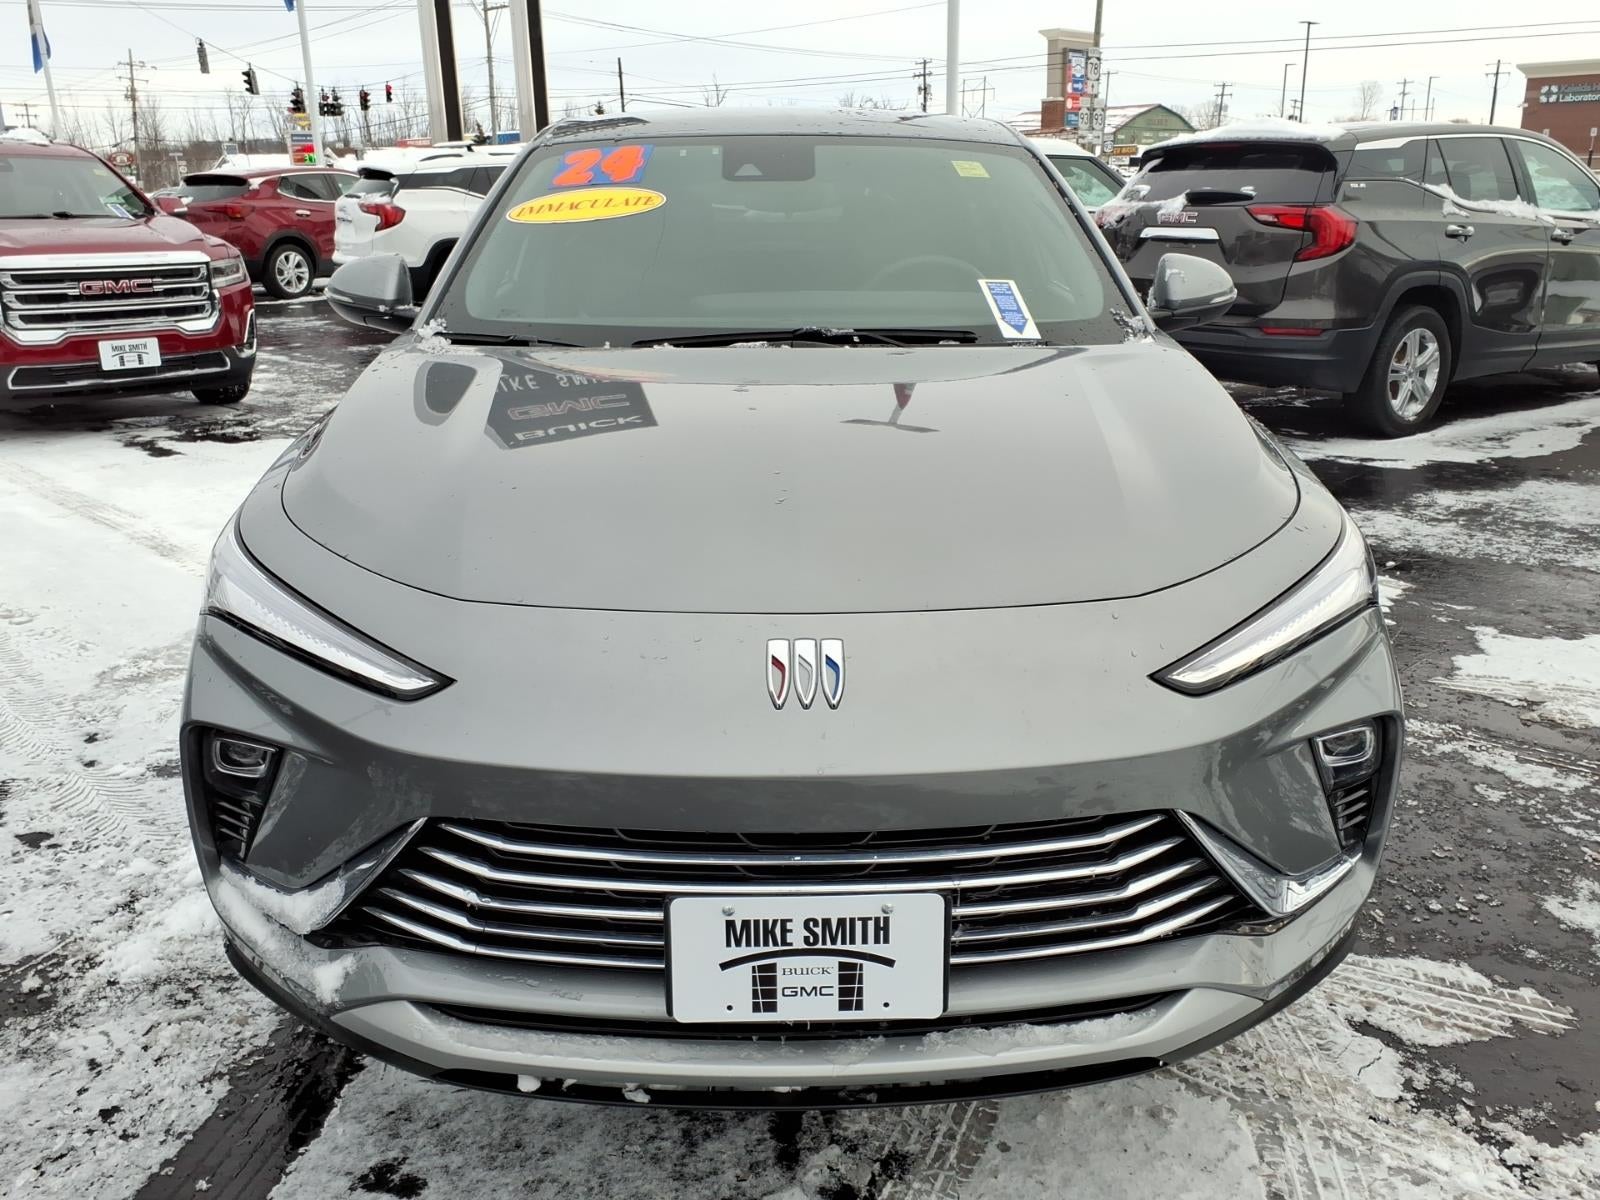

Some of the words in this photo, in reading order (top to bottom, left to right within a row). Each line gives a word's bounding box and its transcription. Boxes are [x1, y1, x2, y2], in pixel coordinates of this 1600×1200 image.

[1089, 62, 1098, 75] 78
[1080, 112, 1088, 125] 93
[1094, 113, 1102, 126] 93
[553, 145, 645, 186] 24
[516, 196, 657, 217] IMMACULATE
[80, 279, 154, 295] GMC
[725, 918, 793, 947] MIKE
[803, 916, 890, 947] SMITH
[781, 985, 834, 997] GMC
